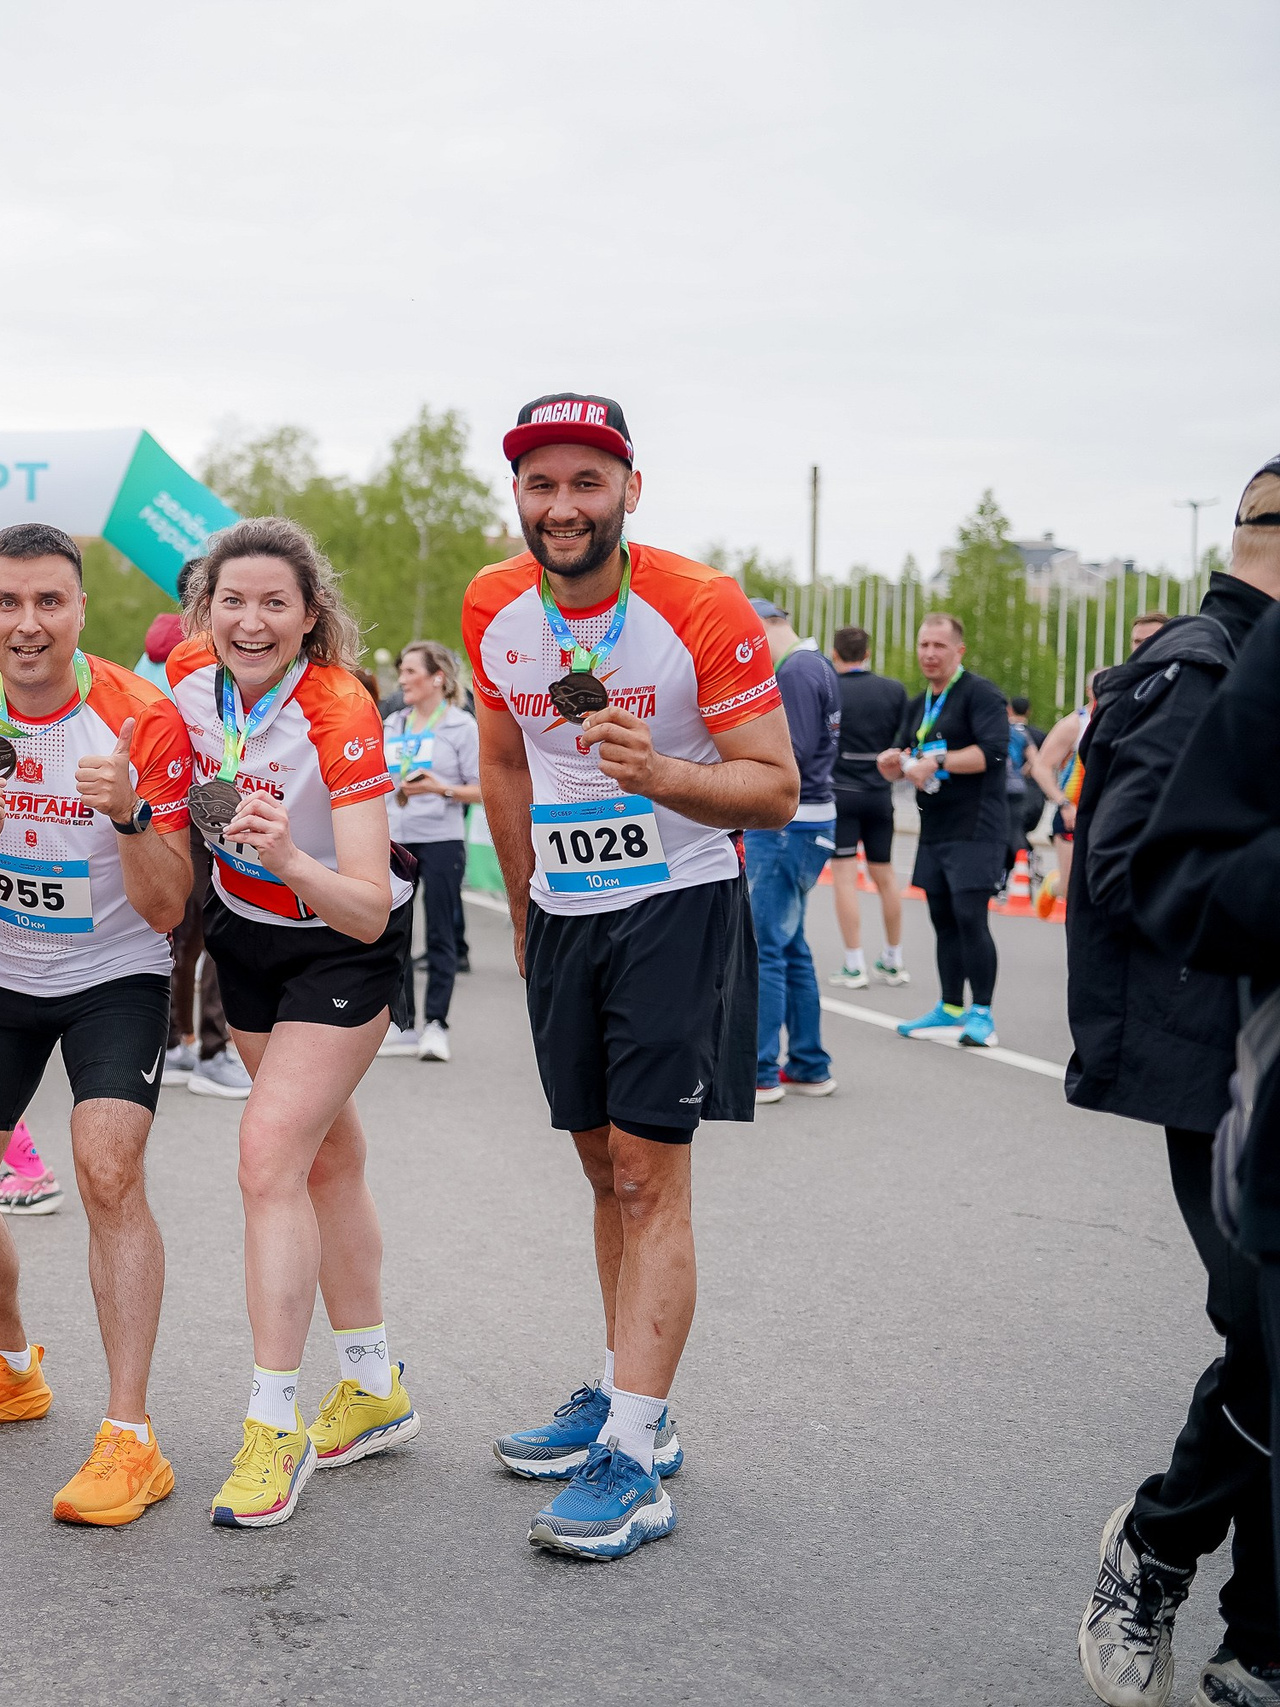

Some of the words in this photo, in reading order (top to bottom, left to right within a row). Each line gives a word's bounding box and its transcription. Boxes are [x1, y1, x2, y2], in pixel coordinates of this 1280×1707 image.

[585, 404, 606, 425] RC
[21, 813, 71, 826] ЛЮБИТЕЛЕЙ
[548, 823, 649, 865] 1028
